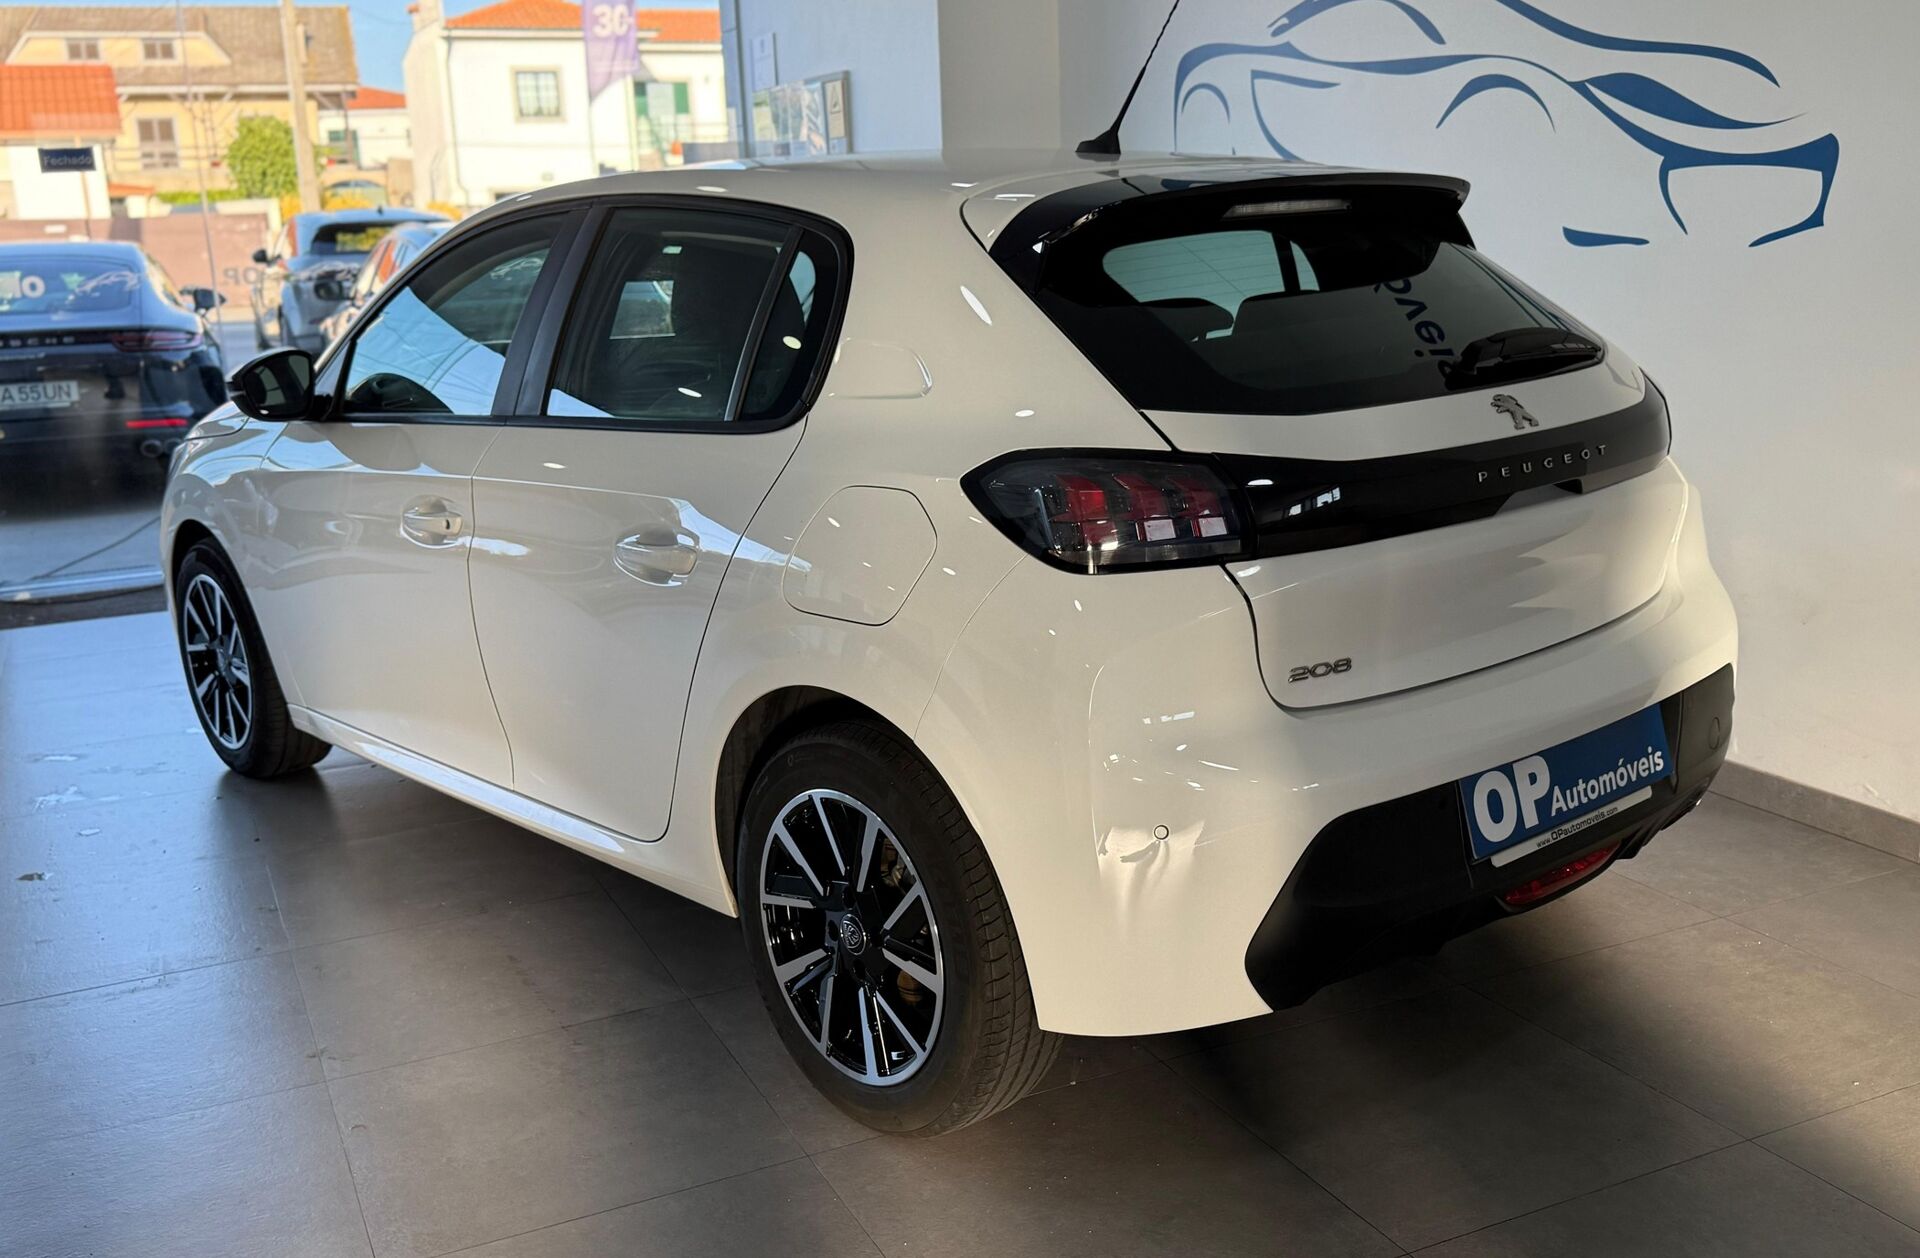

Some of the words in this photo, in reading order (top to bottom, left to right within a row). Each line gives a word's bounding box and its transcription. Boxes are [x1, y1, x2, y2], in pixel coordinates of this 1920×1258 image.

[1478, 445, 1606, 482] PEUGEOT
[1288, 657, 1352, 683] 208
[1473, 755, 1551, 843] OP
[1551, 746, 1664, 817] Automóveis
